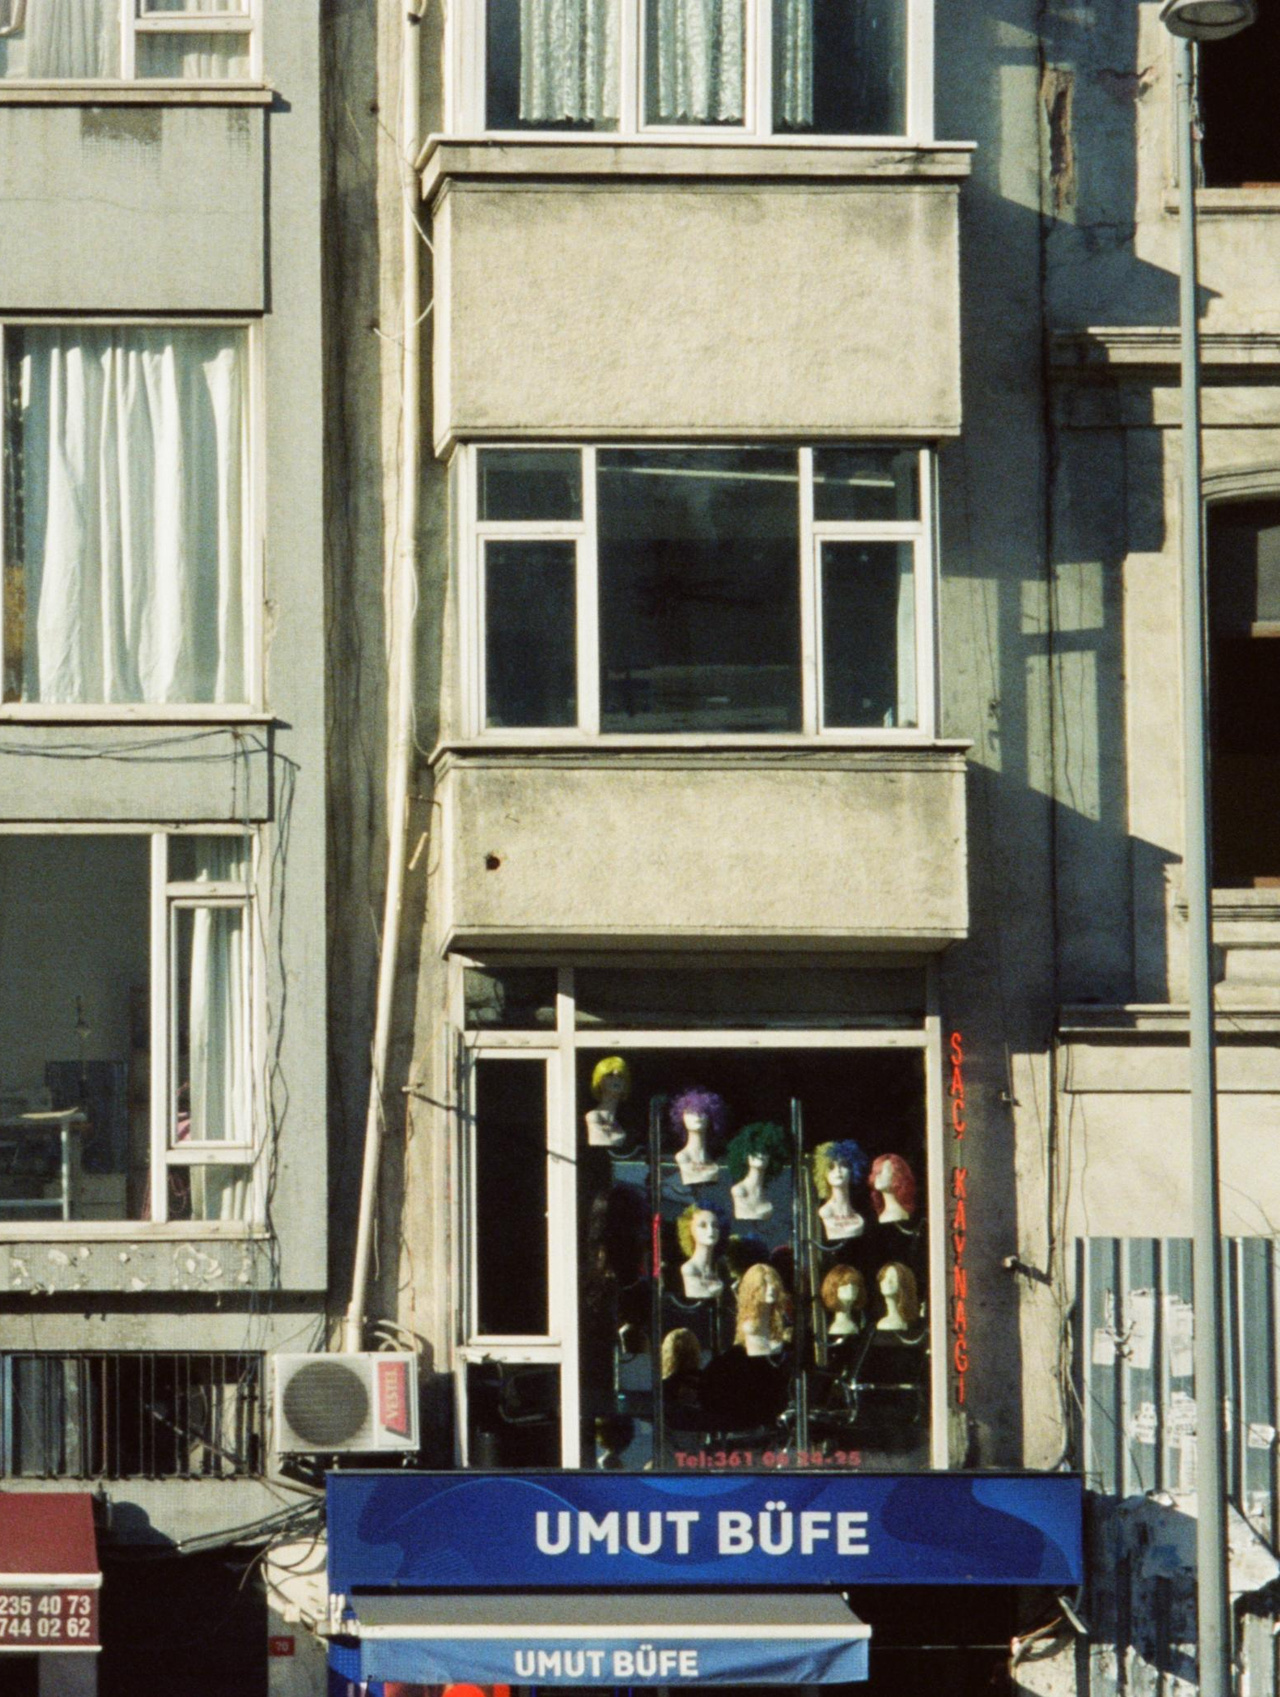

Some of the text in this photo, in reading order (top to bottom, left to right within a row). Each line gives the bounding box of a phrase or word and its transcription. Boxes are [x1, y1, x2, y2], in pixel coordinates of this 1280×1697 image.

[535, 1500, 870, 1555] UMUT BÜFE
[37, 1595, 62, 1615] 40
[67, 1595, 90, 1615] 73
[37, 1617, 60, 1637] 02
[67, 1617, 90, 1637] 62
[514, 1644, 698, 1678] UMUT BÜFE
